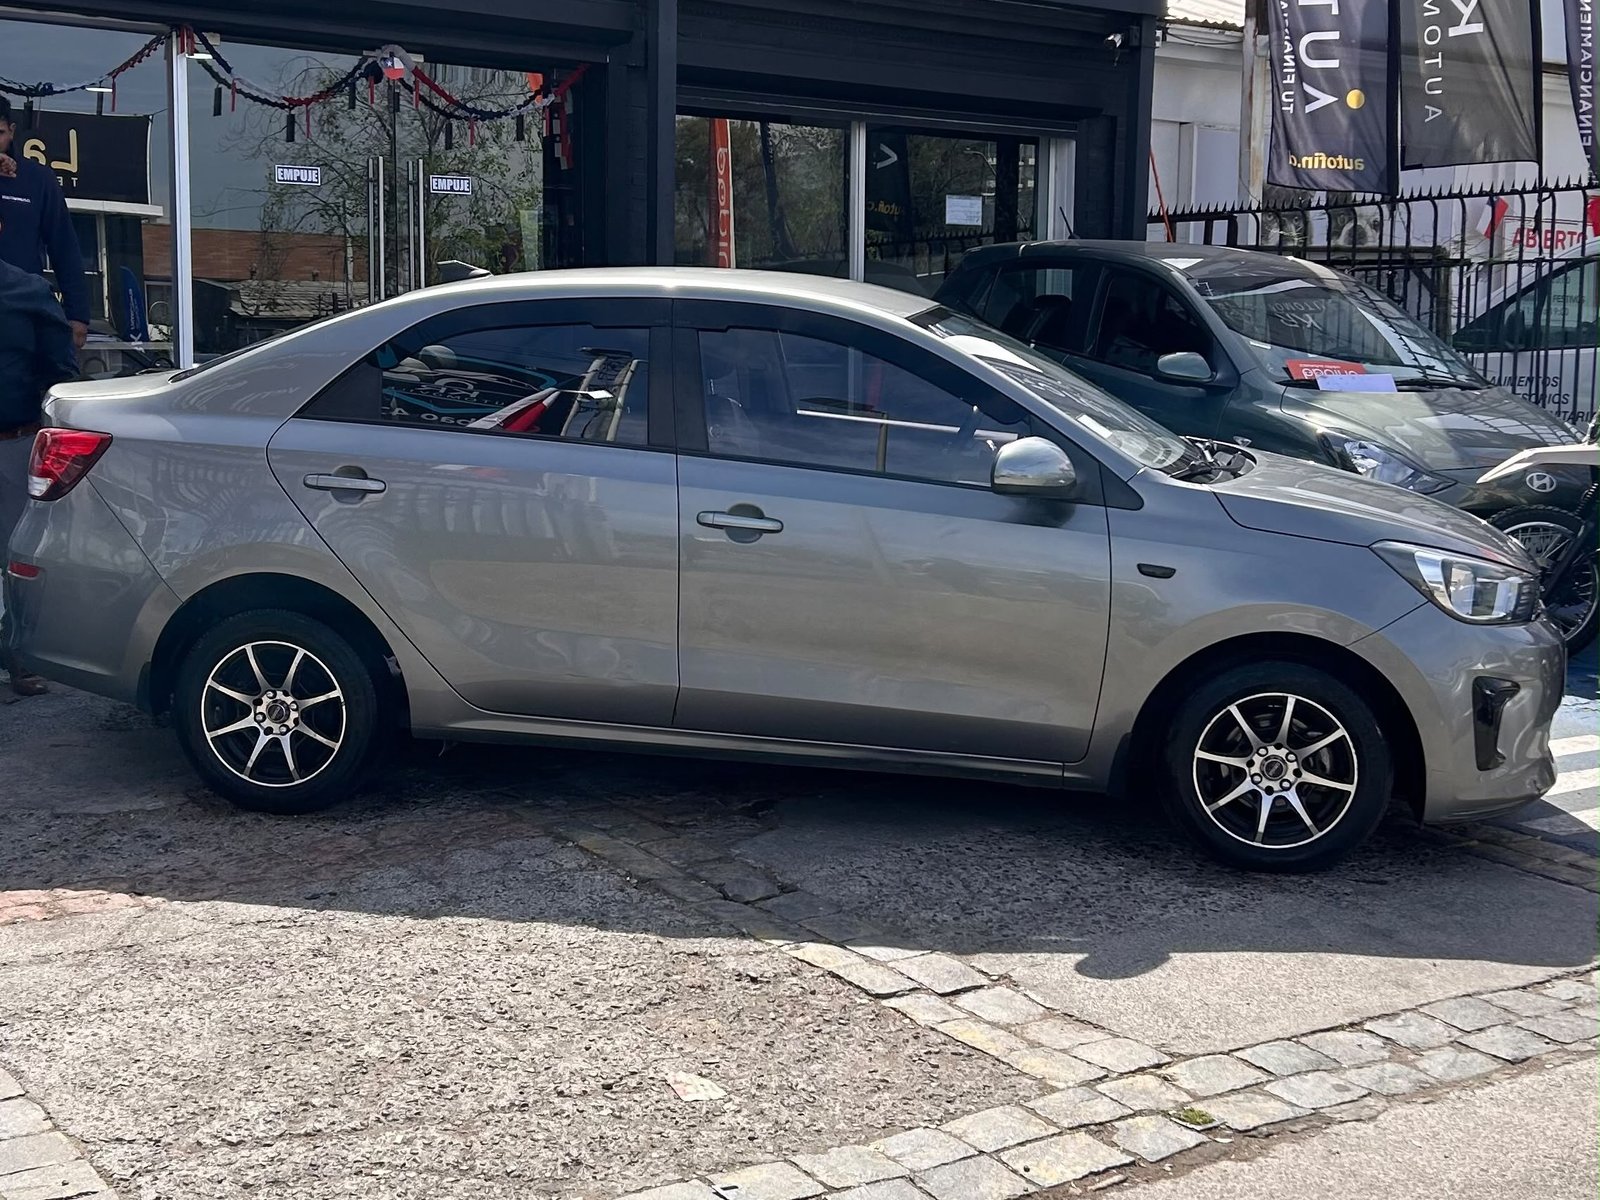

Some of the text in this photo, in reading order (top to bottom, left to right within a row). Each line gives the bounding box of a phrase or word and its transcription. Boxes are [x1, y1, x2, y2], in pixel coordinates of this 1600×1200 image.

[277, 167, 318, 182] EMPUJE
[432, 178, 470, 192] EMPUJE
[1512, 227, 1588, 250] ABERT
